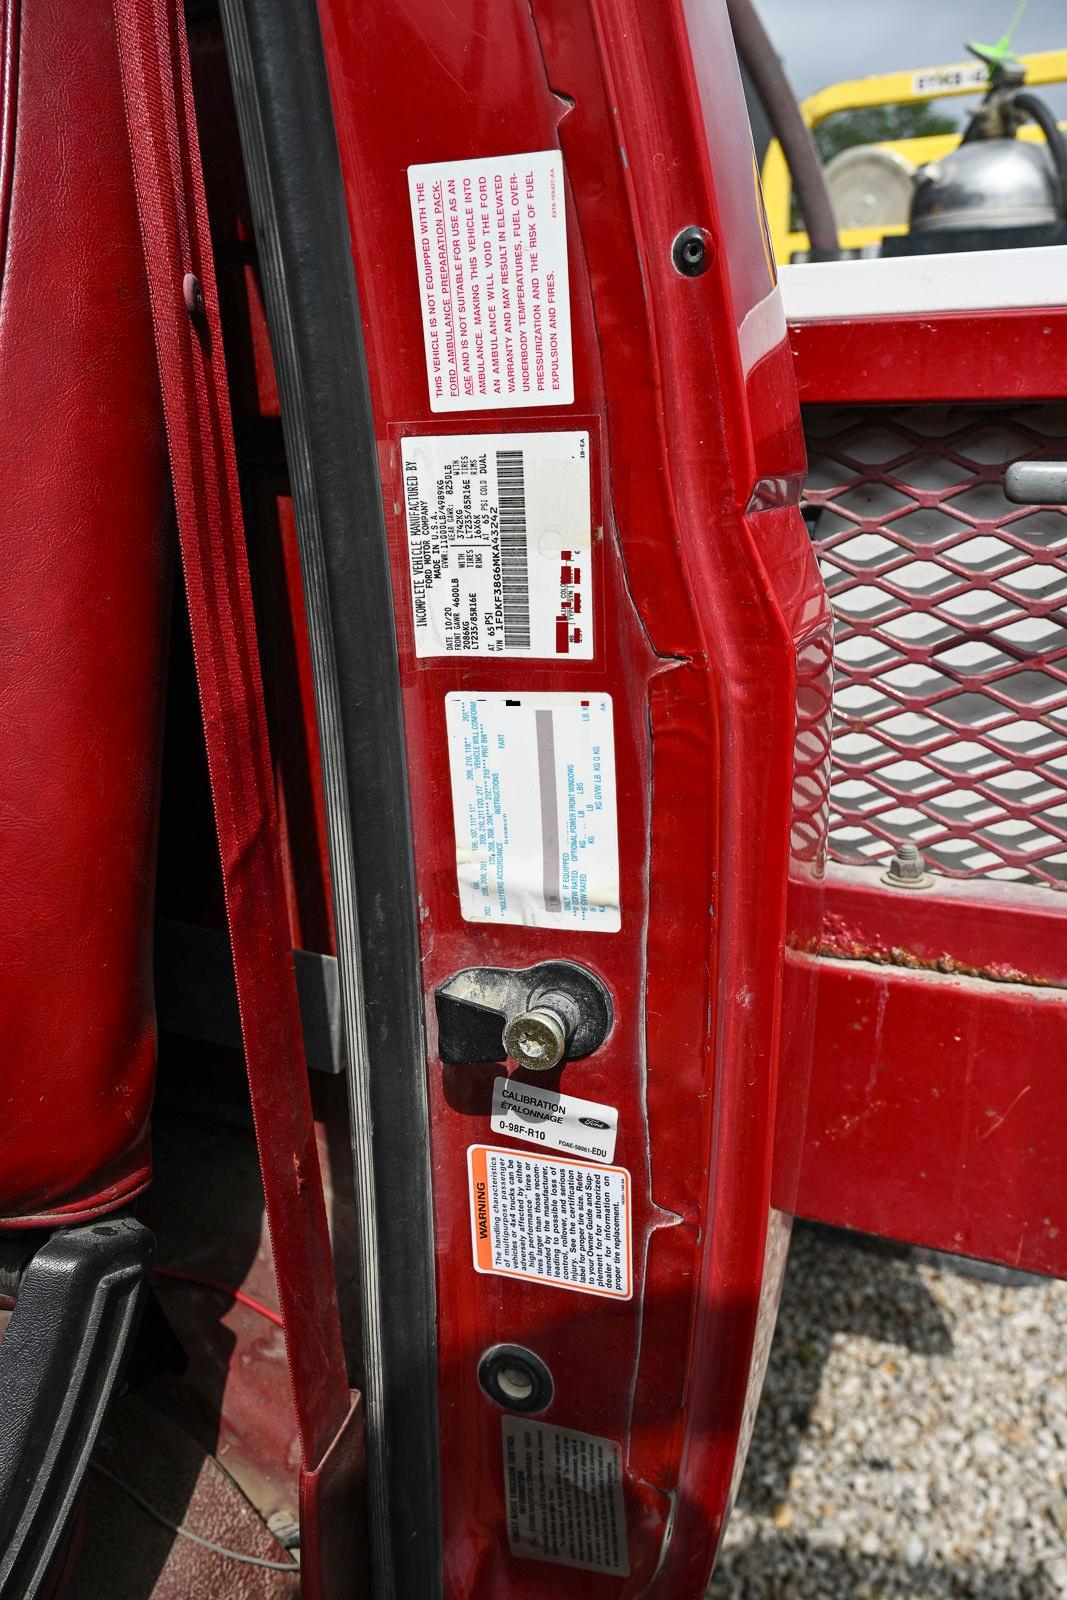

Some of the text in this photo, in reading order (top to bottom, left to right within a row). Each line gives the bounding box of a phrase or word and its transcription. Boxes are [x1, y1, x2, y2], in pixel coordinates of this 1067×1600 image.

[416, 182, 443, 398] THIS VEHICLE NOT EQUIPPED WITH THE
[432, 181, 458, 397] FORD AMBULANCE PREPARATION PACK-
[447, 179, 472, 396] AGE AND NOT SUITABLE FOR USE AN
[462, 178, 486, 394] AMBULANCE. MAKING THIS VEHICLE INTO
[478, 176, 501, 394] AN AMBULANCE WILL VOID THE FORD
[494, 175, 515, 393] WARRANTY AND MAY RESULT IN ELEVATED
[510, 173, 530, 392] UNDERBODY TEMPERATURES, FUEL OVER-
[525, 171, 544, 391] PRESSURIZATION AND THE RISK OF FUEL
[546, 271, 560, 390] EXPULSION AND FIRES.
[444, 464, 456, 541] REAR GAWR: 8250LB
[452, 460, 460, 476] WITH
[460, 455, 473, 539] LT235/85R16E TIRES
[469, 459, 478, 475] RIMS
[478, 453, 490, 541] AT 65 PSI COLD DUAL
[405, 461, 427, 627] INCOMPLETE VEHICLE MANUFACTURED BY
[420, 500, 433, 589] FORD MOTOR COMPANY
[430, 511, 441, 579] MADE IN U.S.A.
[455, 509, 465, 539] 3742KG
[465, 549, 474, 568] TIRES
[458, 553, 466, 569] WITH
[474, 553, 483, 569] RIMS
[490, 507, 503, 630] 1FDKF38G6MKA43242
[444, 607, 454, 651] DATE 10/20
[451, 578, 462, 651] FRONT GAWR 4600LB
[462, 621, 471, 650] 2086KG
[468, 593, 479, 650] LT235/85R16E
[484, 612, 495, 652] AT 65 PSI
[469, 701, 478, 730] CONFORM
[472, 745, 481, 769] VEHICLE
[491, 772, 501, 815] INSTRUCTIONS
[567, 764, 578, 862] OPTIONAL POWER FRONT WINDOWS
[495, 842, 504, 880] ACCORDANCE
[562, 852, 570, 883] EQUIPPED
[562, 896, 572, 911] ONLY
[499, 1120, 546, 1140] 0-98F-R10
[500, 1100, 564, 1124] ÉTALONNAGE
[502, 1090, 566, 1114] CALIBRATION
[477, 1182, 487, 1239] WARNING
[490, 1157, 501, 1249] handling characteristics
[499, 1158, 510, 1256] multipurpose passenger
[515, 1160, 527, 1271] adversely affected either
[575, 1171, 583, 1192] Refer
[576, 1194, 584, 1211] size.
[603, 1192, 611, 1241] information
[508, 1187, 519, 1269] vehicles trucks
[524, 1174, 536, 1268] high performance" tires
[536, 1235, 544, 1256] larger
[550, 1179, 561, 1278] leading possible loss
[558, 1168, 569, 1280] control, rollover, serious
[567, 1170, 579, 1282] injury. certification
[584, 1172, 596, 1275] your Owner Guide Sup-
[593, 1174, 605, 1287] plement authorized
[613, 1202, 623, 1291] proper tire replacement.
[544, 1247, 552, 1276] mended
[578, 1265, 586, 1283] label
